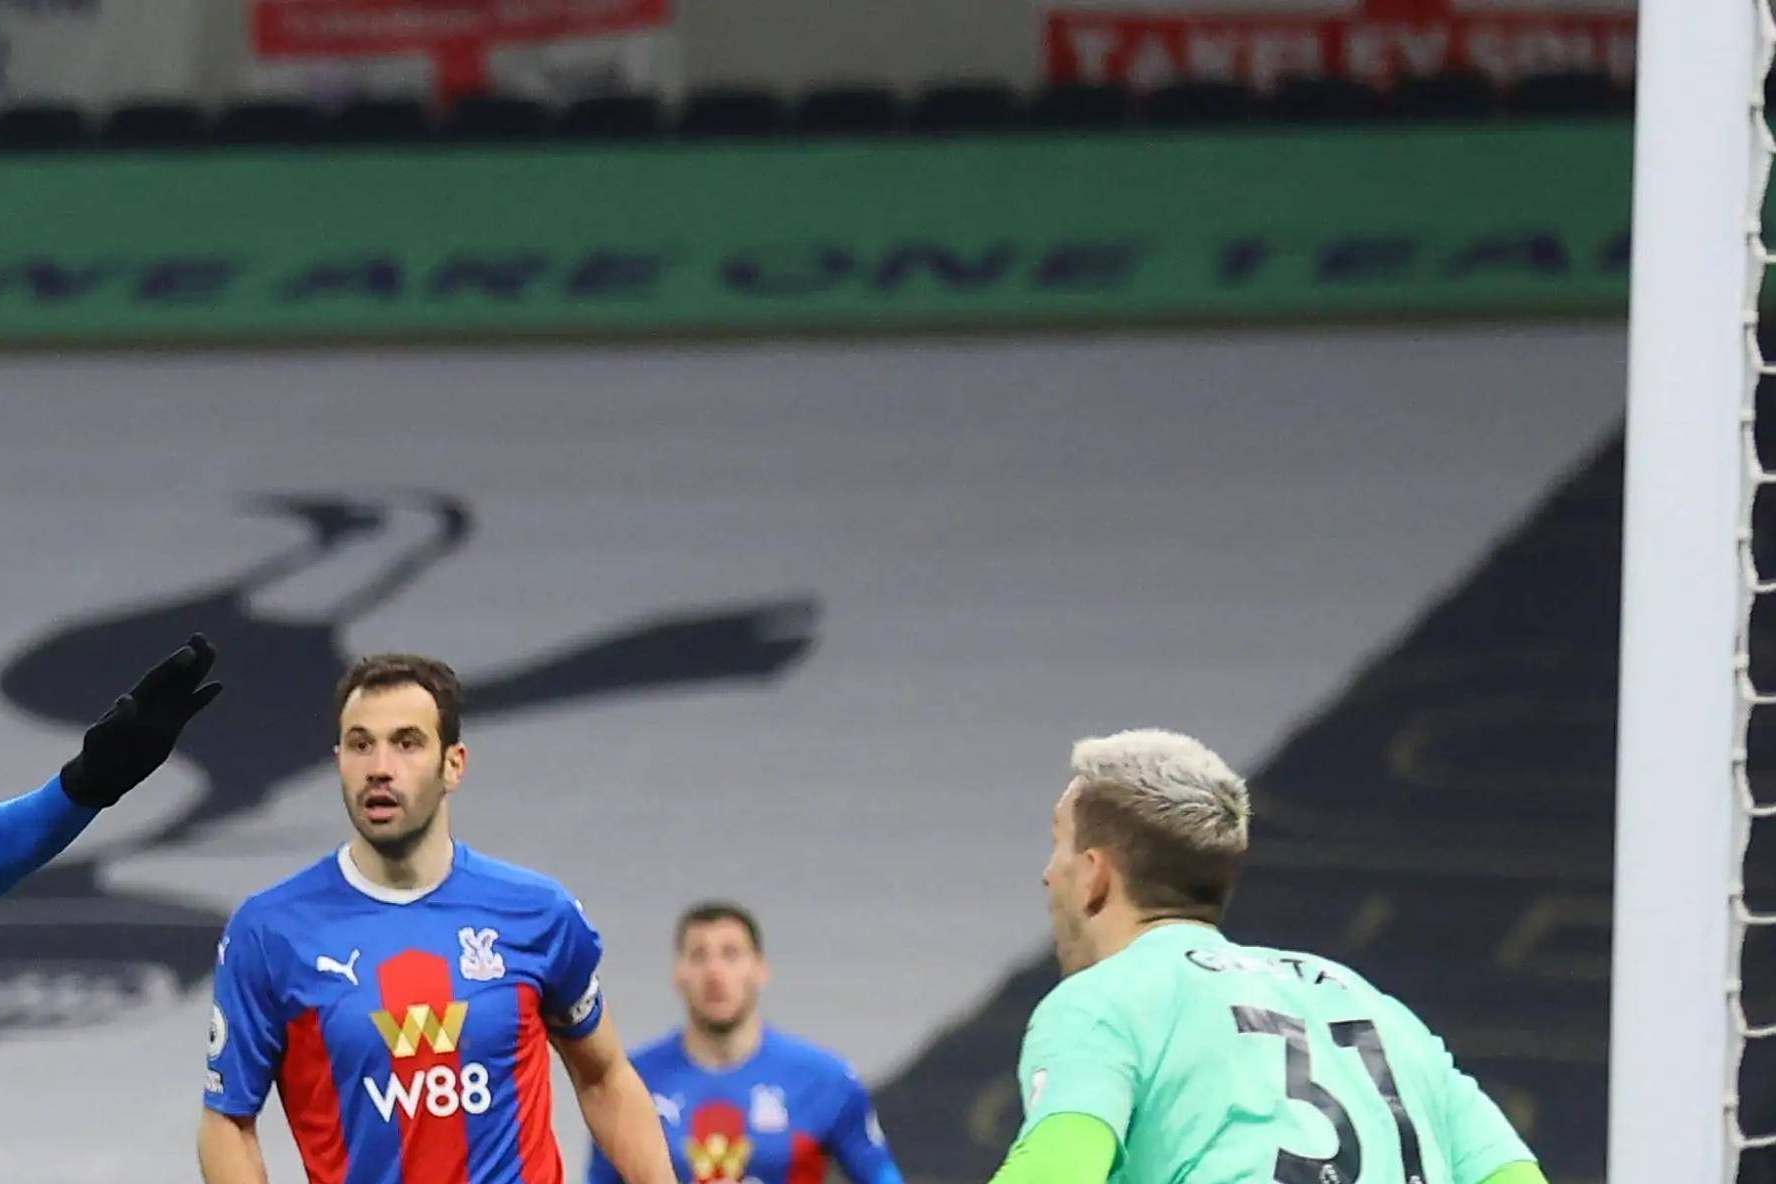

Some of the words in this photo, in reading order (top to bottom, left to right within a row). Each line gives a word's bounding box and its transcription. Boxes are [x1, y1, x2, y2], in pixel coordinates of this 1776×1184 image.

[279, 248, 669, 300] ARE
[716, 238, 1154, 297] ONE
[363, 1061, 492, 1123] W88
